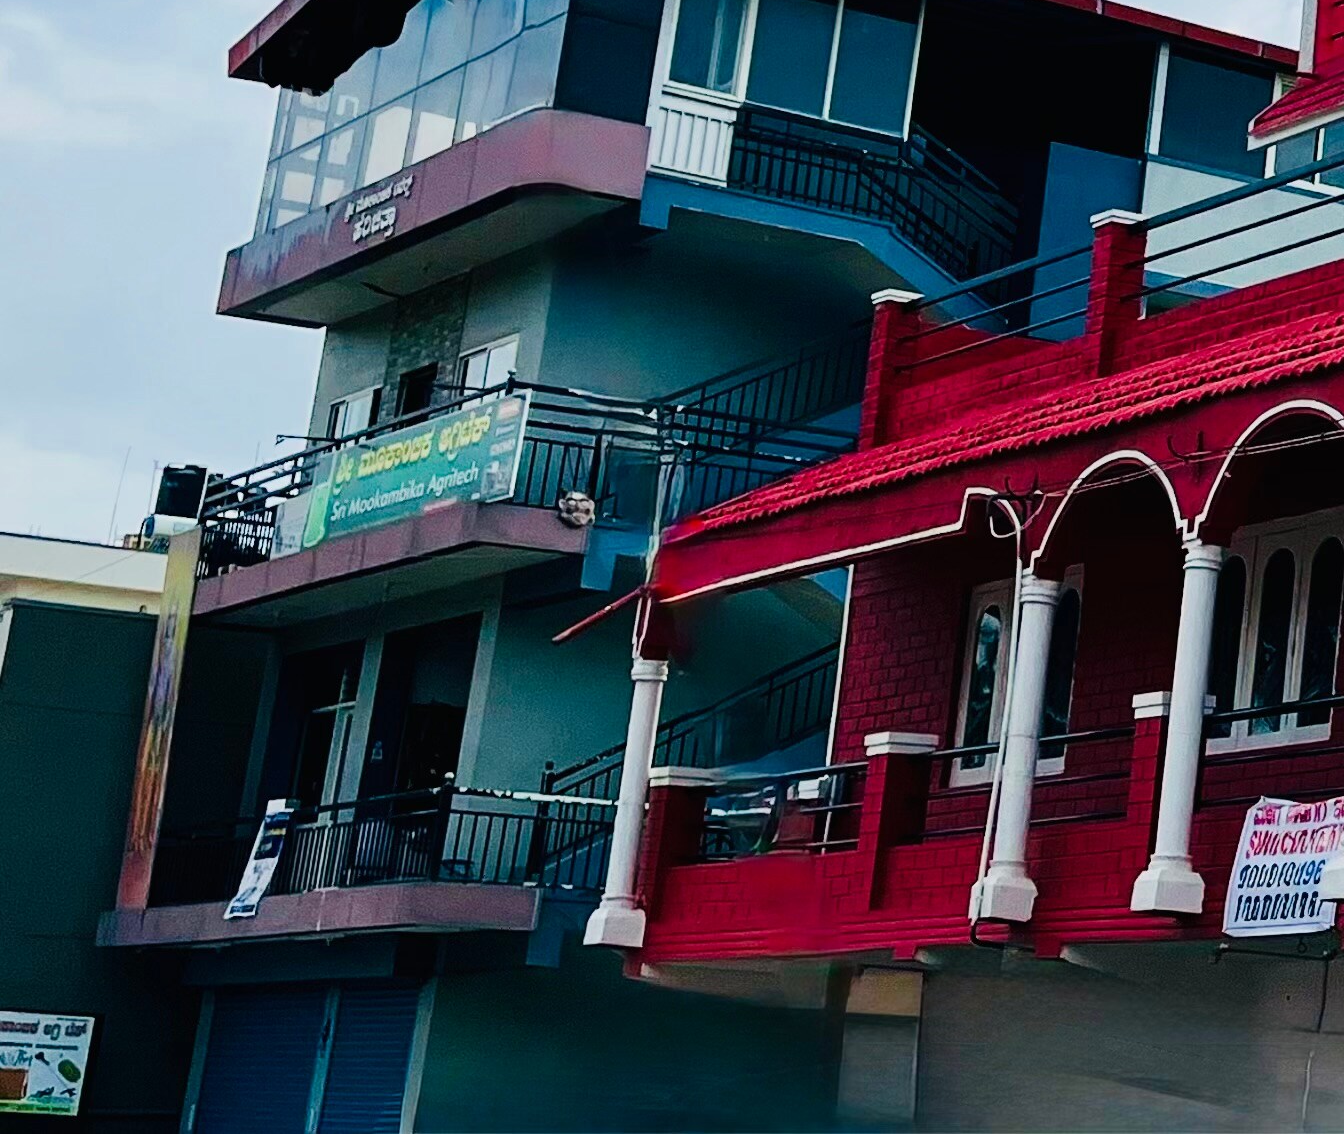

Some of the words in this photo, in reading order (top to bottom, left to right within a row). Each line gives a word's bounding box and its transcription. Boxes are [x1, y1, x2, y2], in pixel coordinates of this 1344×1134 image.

[330, 499, 347, 521] Sri
[348, 479, 425, 516] Mookambika
[426, 461, 480, 496] Agritech
